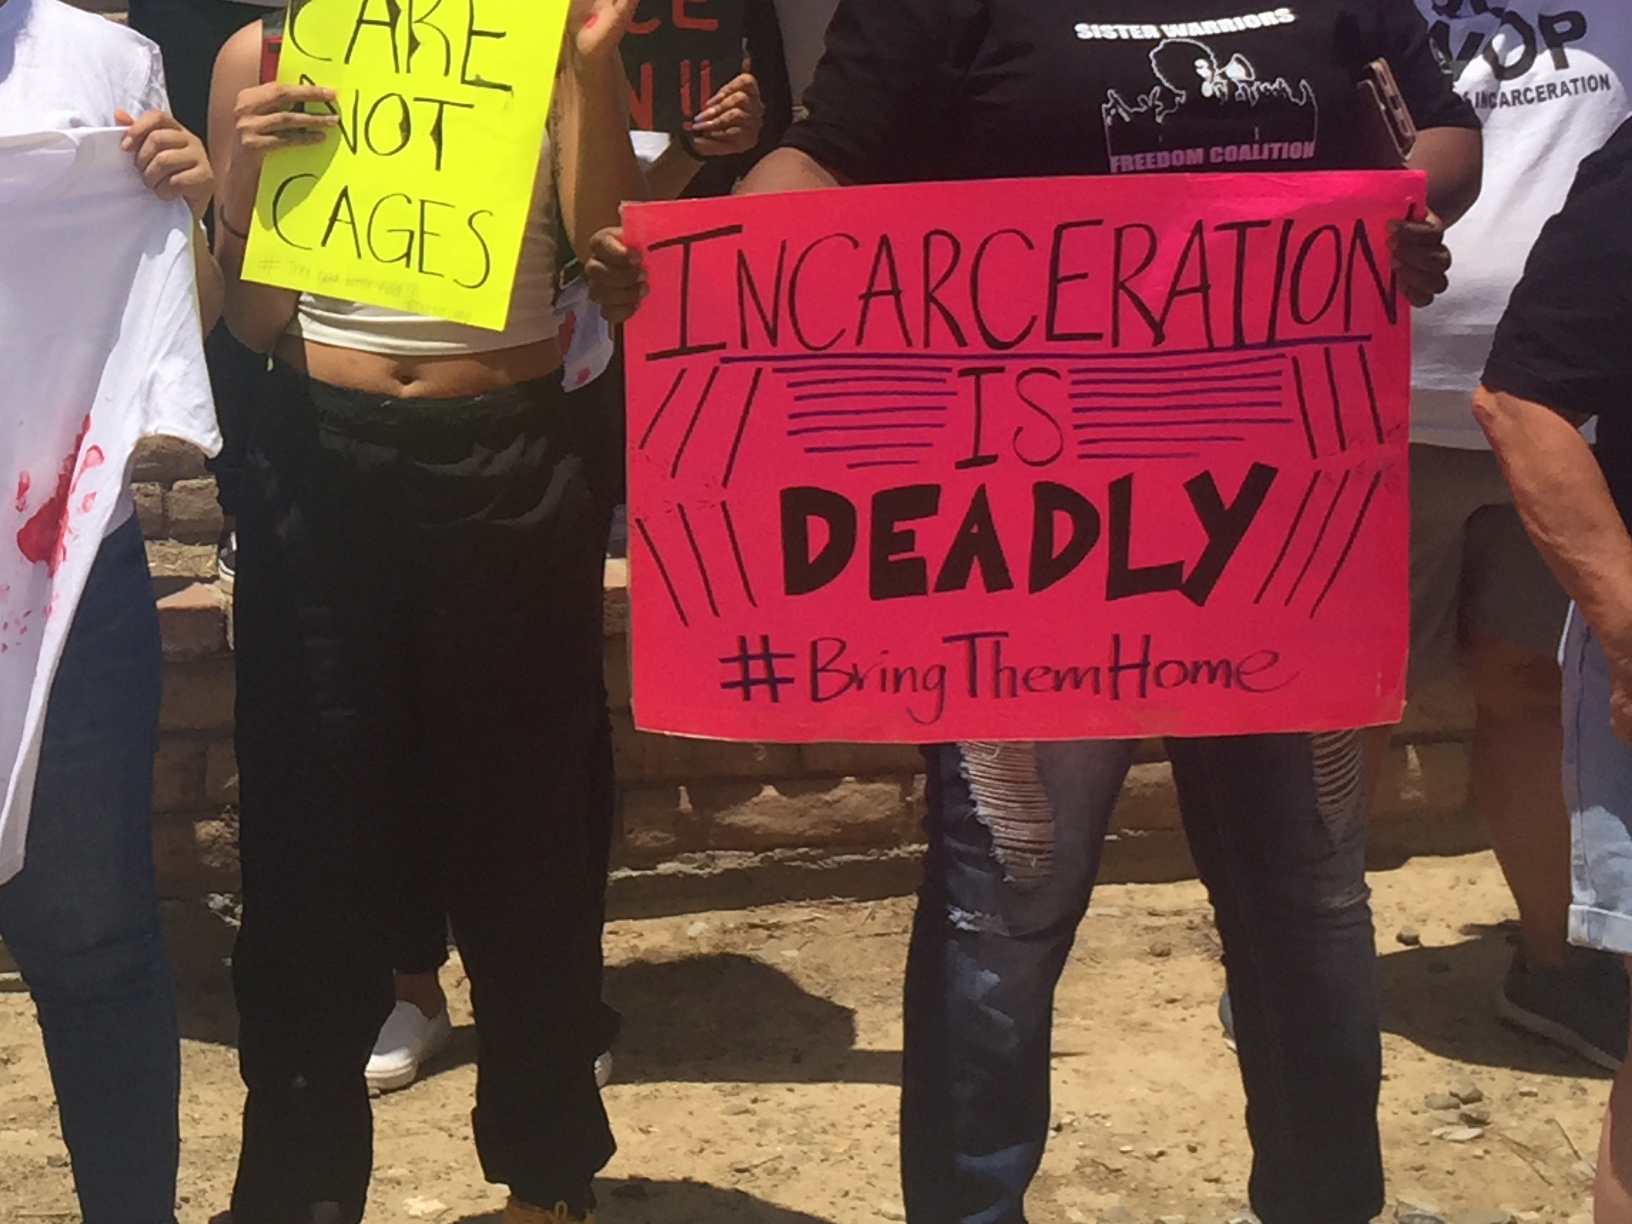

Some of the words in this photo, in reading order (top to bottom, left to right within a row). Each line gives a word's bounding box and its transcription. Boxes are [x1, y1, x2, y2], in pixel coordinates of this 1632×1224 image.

[291, 74, 475, 172] NOT
[1110, 147, 1205, 173] FREEDOM
[1210, 141, 1317, 164] COALITION
[272, 173, 494, 289] CAGES
[645, 207, 1414, 360] INCARCERATION
[954, 367, 1064, 469] IS
[779, 462, 1279, 607] DEADLY
[719, 631, 1299, 726] #BringThemHome
